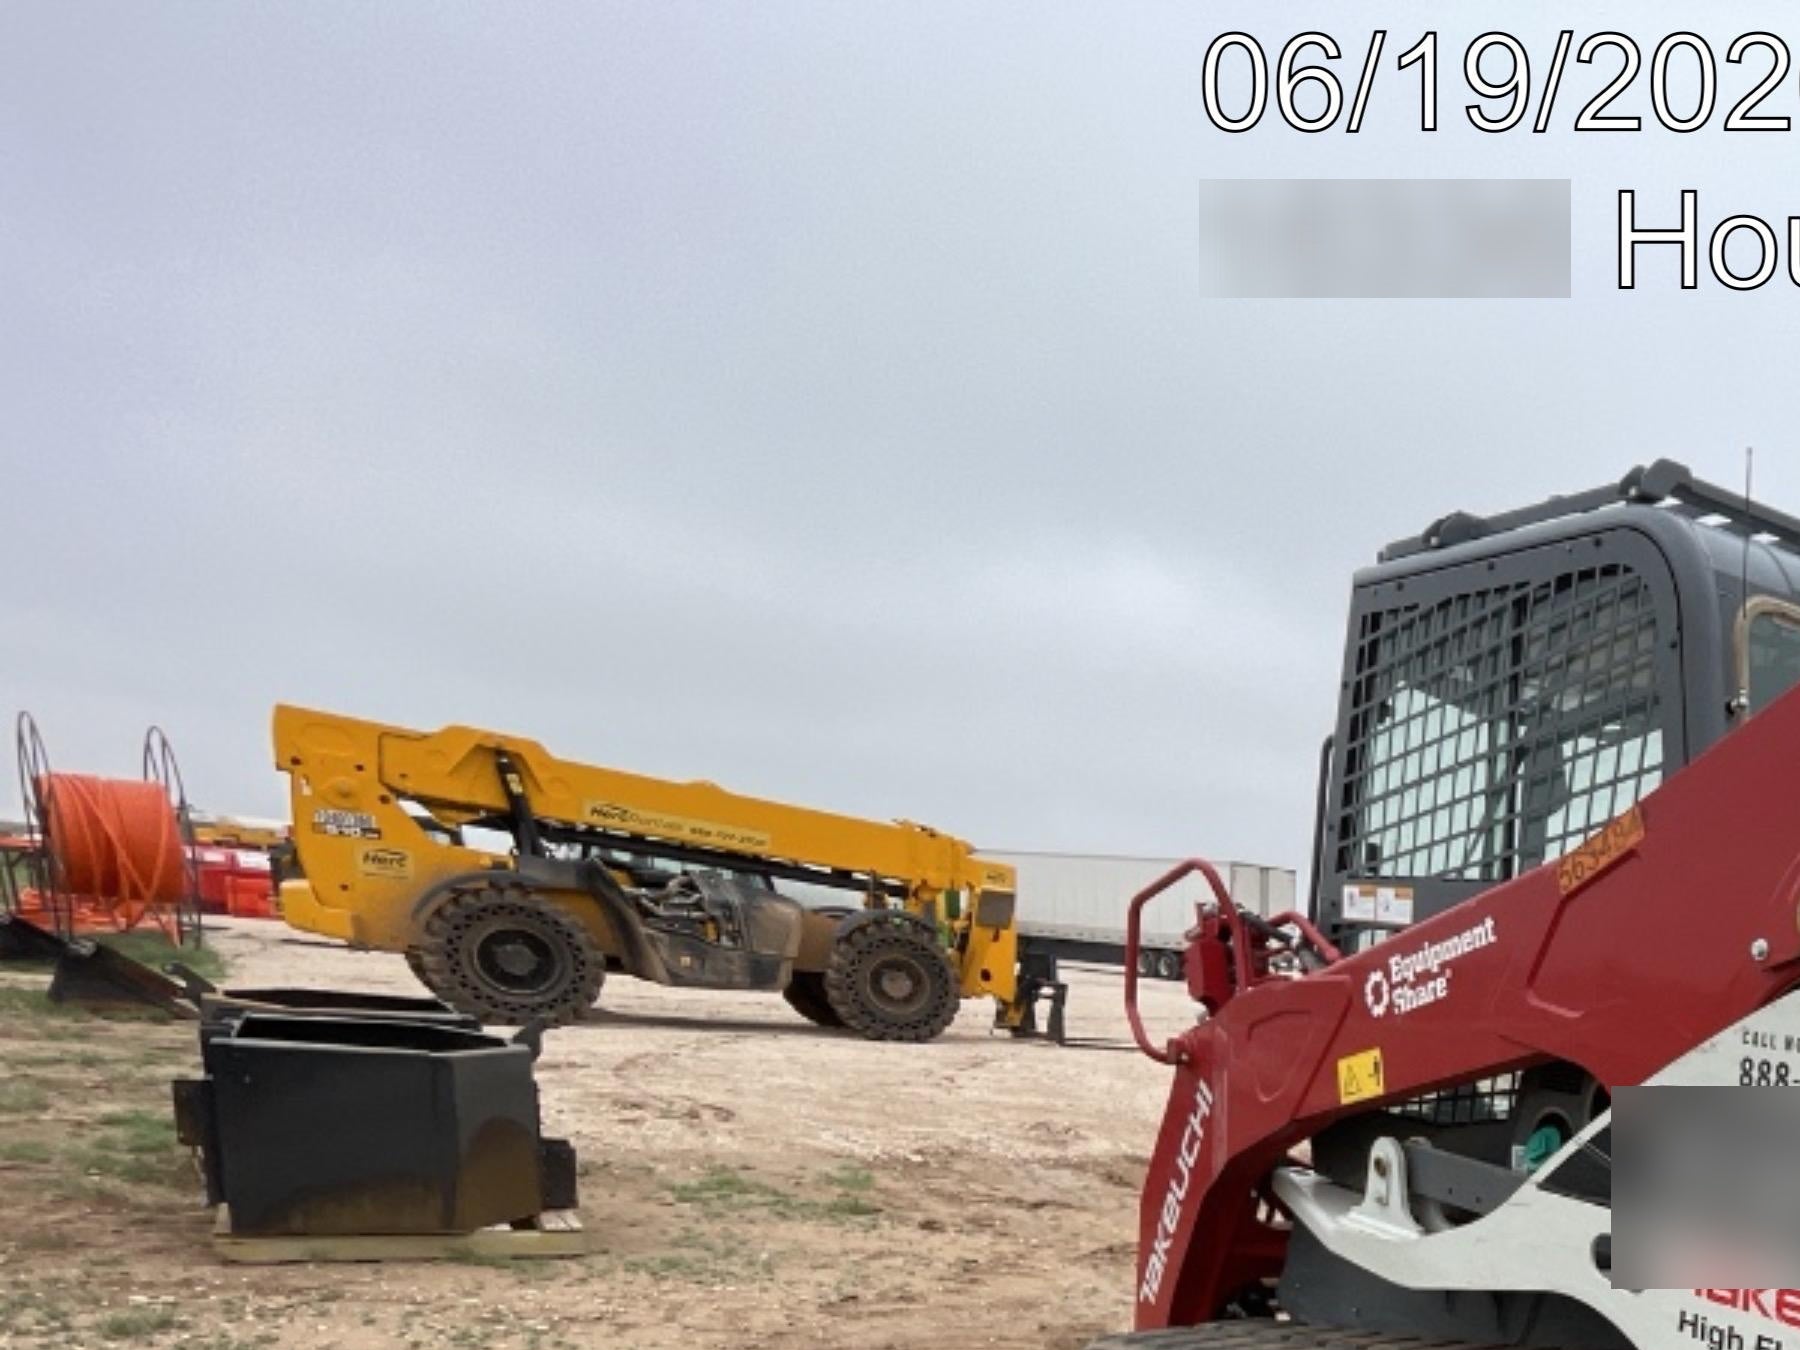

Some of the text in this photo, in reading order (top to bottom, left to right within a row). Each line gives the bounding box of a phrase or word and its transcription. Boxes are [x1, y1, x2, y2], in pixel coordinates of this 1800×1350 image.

[1388, 916, 1498, 984] Equipment
[1391, 976, 1448, 1015] Share
[1742, 1030, 1777, 1051] CALL
